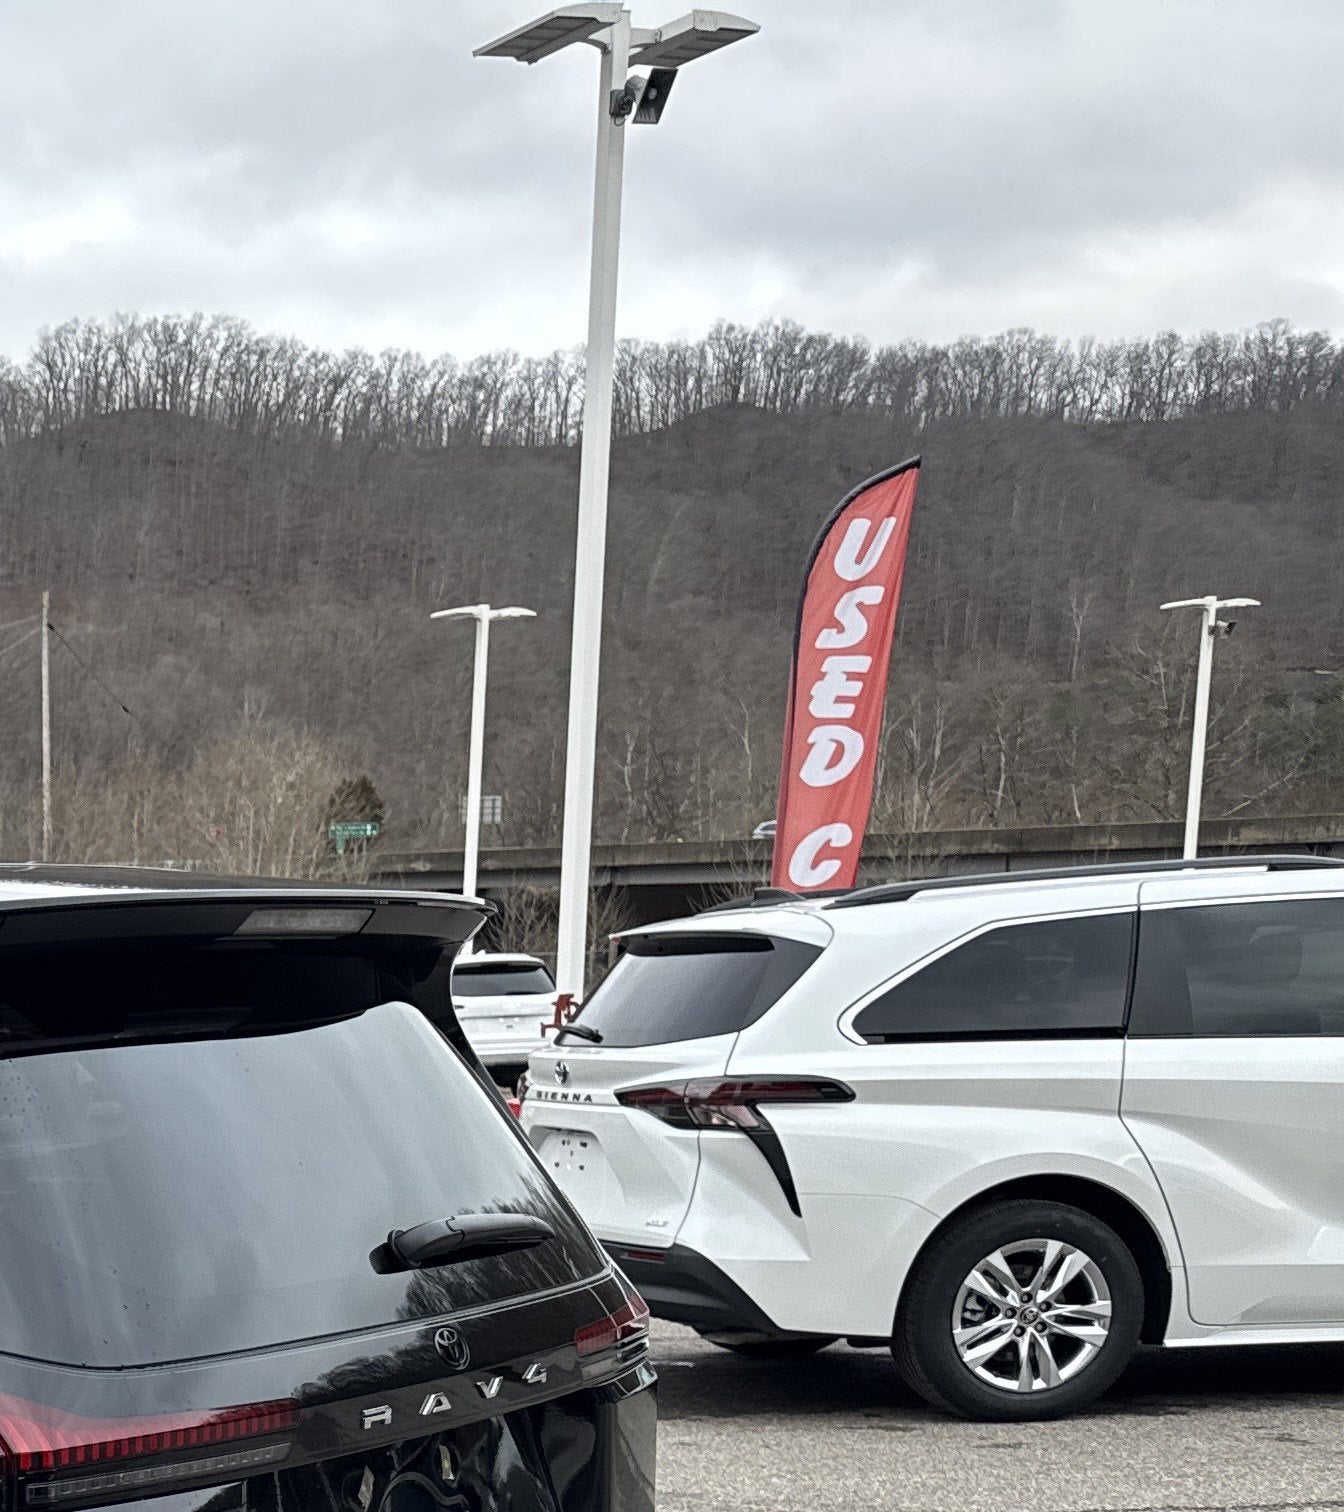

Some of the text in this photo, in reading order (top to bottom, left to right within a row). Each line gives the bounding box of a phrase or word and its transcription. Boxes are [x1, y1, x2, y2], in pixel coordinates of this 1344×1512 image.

[800, 517, 896, 787] USED
[536, 1090, 592, 1103] SIENNA
[362, 1363, 547, 1429] RAV4
